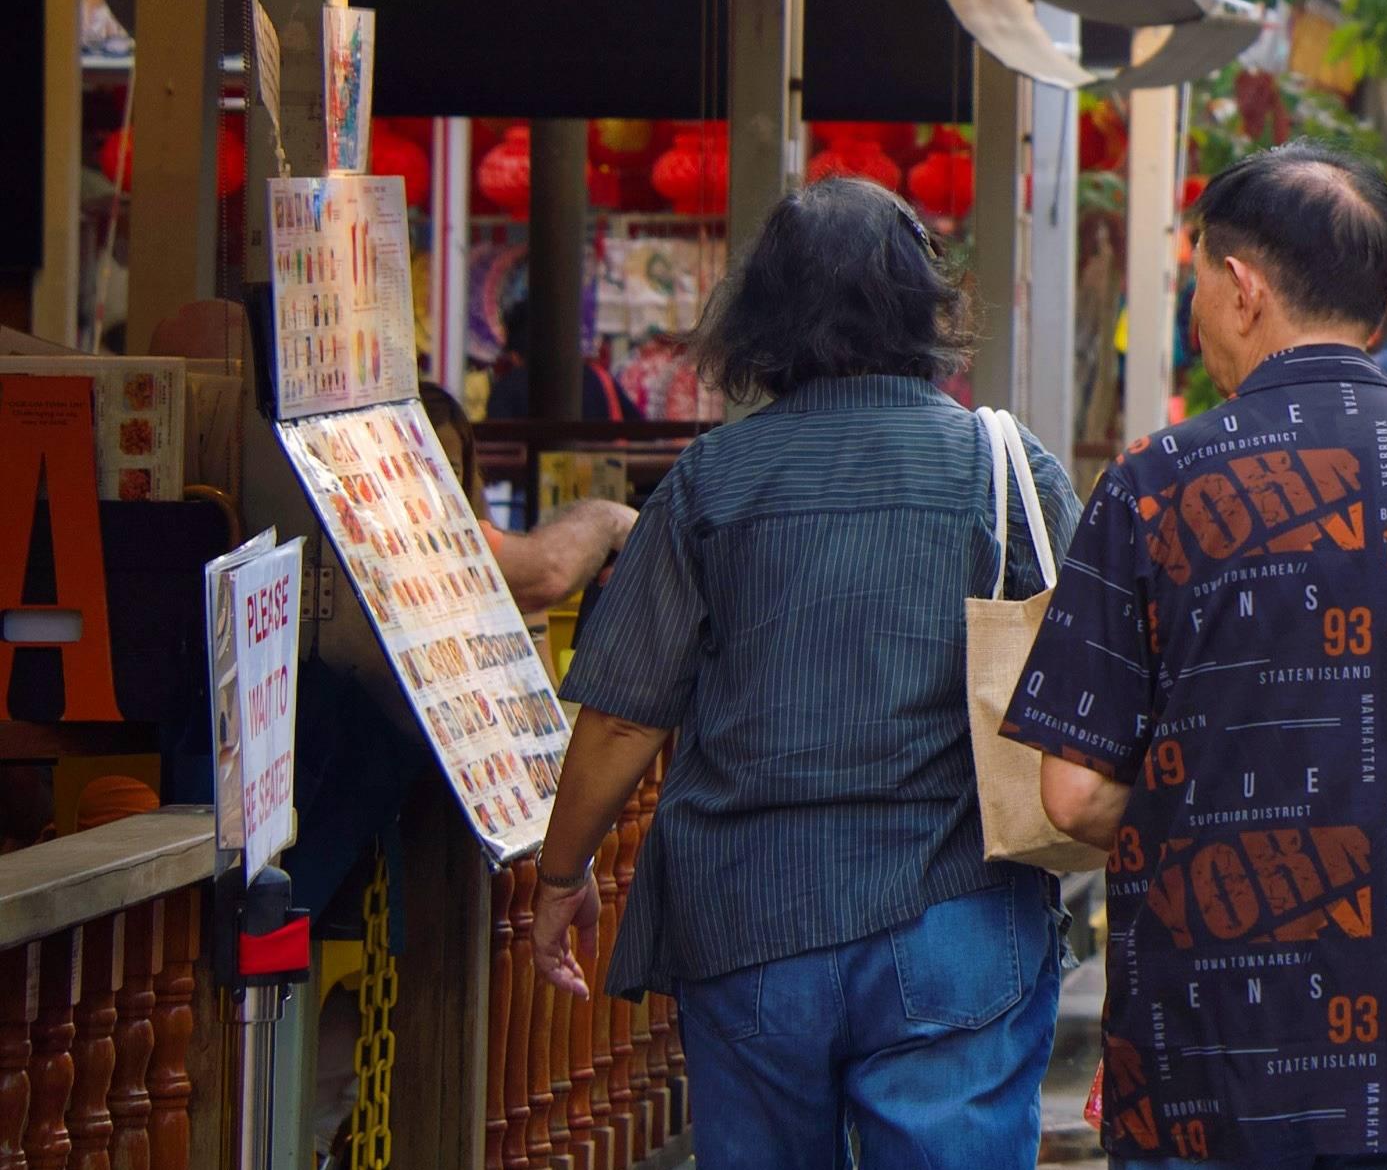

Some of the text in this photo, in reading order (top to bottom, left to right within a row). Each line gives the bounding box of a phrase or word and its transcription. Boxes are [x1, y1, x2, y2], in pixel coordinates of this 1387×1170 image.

[1238, 432, 1298, 449] DISTRICT
[247, 574, 289, 648] PLEASE
[1323, 606, 1373, 657] 93
[1259, 665, 1372, 685] STATEN ISLAND
[248, 664, 287, 741] WAIT TO
[1361, 693, 1375, 783] MANHATTAN
[245, 750, 293, 839] BE SEATED
[1252, 805, 1312, 819] DISTRICT
[1328, 995, 1379, 1044] 93
[1267, 1053, 1377, 1075] STATEN ISLAND
